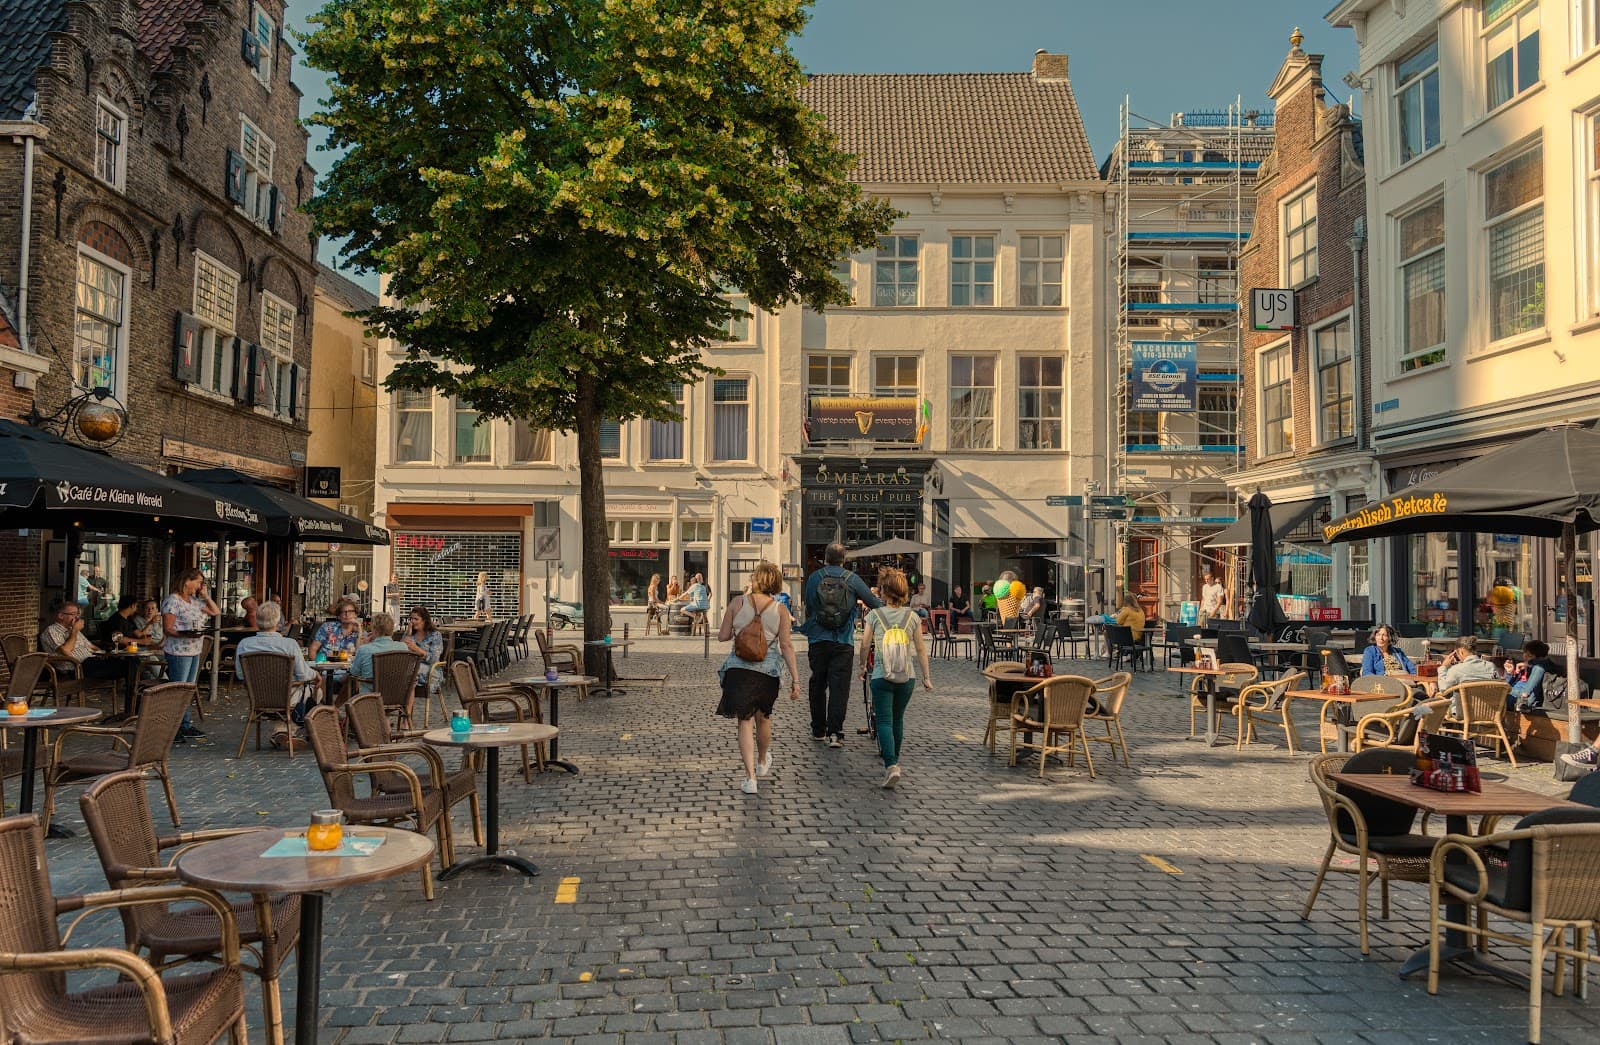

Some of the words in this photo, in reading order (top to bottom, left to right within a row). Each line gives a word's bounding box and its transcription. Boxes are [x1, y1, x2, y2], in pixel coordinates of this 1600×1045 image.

[69, 486, 93, 501] Café
[94, 487, 108, 502] De
[109, 489, 135, 505] Kleine
[136, 491, 163, 508] Wereld
[811, 492, 834, 501] THE
[846, 494, 878, 502] IRISH
[889, 493, 912, 502] PUB
[1323, 503, 1392, 540] Australisch
[1391, 491, 1448, 518] Eetcafé
[398, 534, 445, 551] Enjoy
